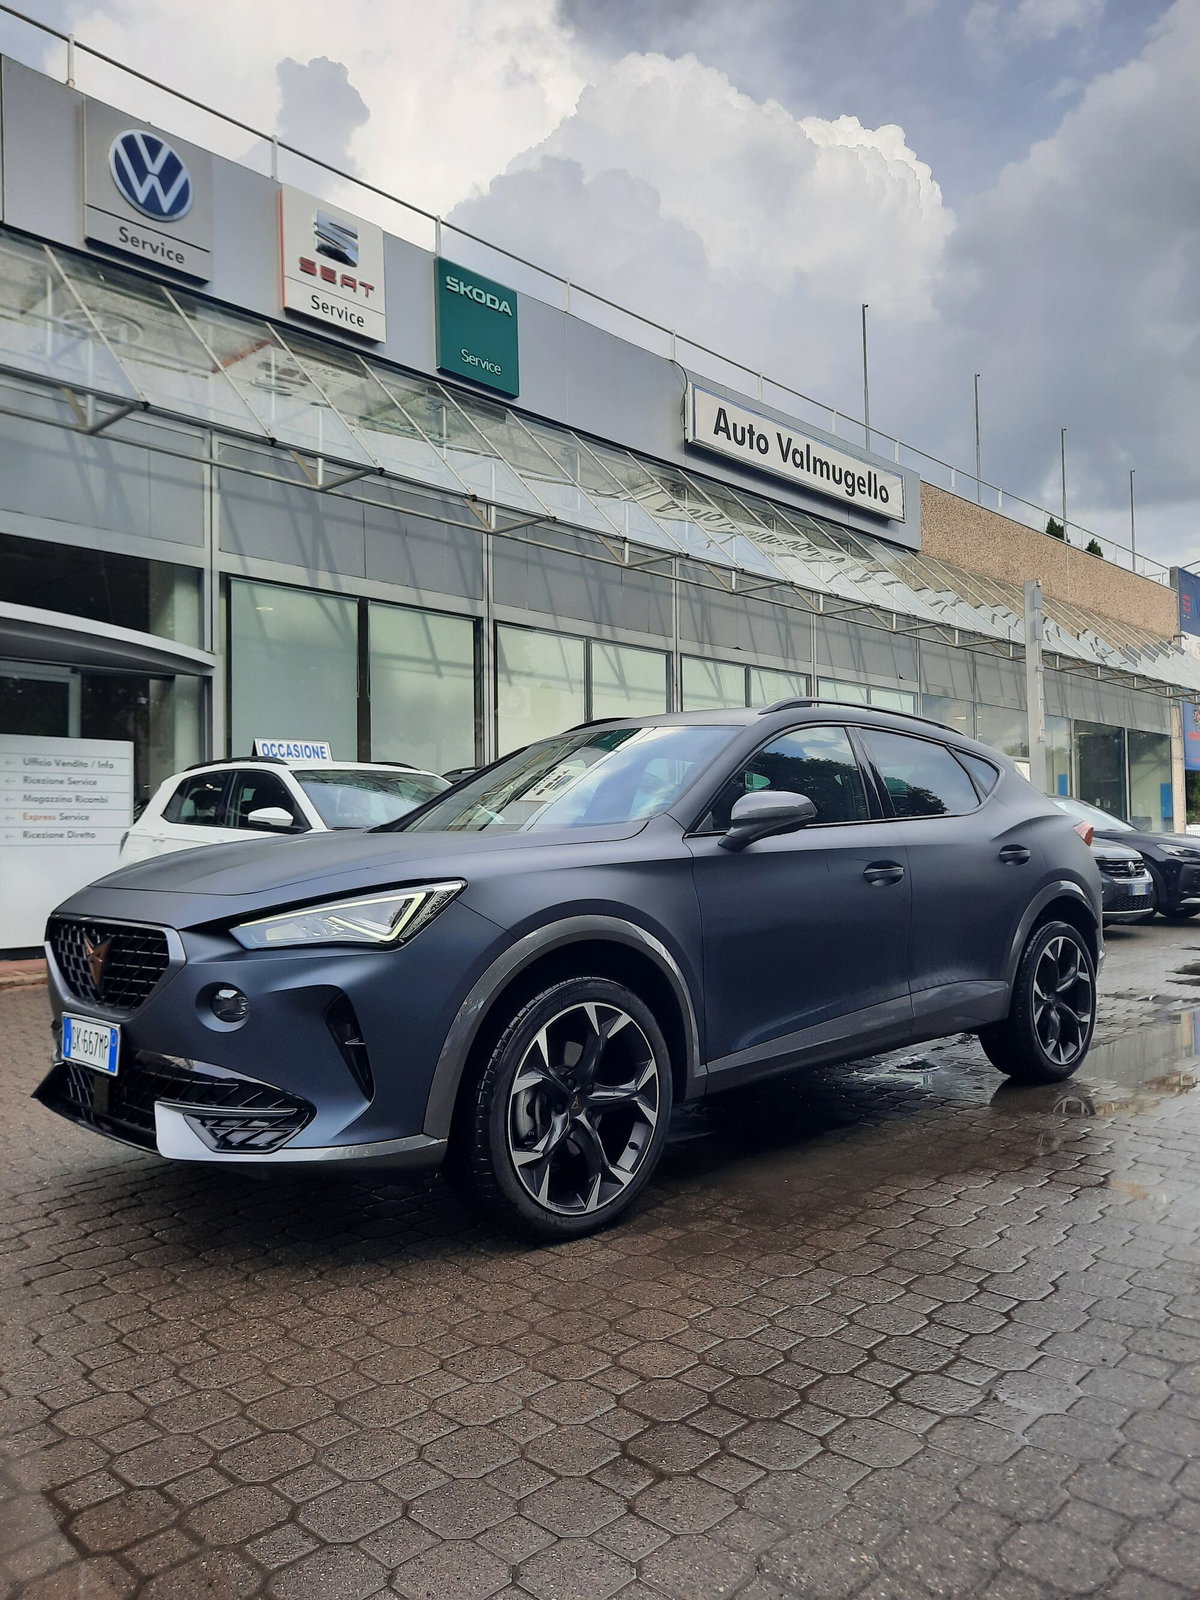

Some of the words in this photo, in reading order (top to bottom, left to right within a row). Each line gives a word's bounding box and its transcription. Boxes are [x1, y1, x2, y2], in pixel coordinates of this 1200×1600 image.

[118, 226, 185, 264] Service
[299, 256, 375, 298] SEAT
[445, 275, 513, 317] SKODA
[310, 294, 365, 327] Service
[460, 348, 502, 375] Service
[713, 407, 769, 455] Auto
[776, 432, 889, 504] Valmugello
[261, 743, 327, 759] OCCASIONE
[23, 757, 52, 767] Ufficio
[97, 760, 114, 769] Info
[23, 775, 65, 785] Ricezione
[67, 777, 98, 786] Service
[23, 794, 73, 804] Magazzino
[75, 795, 109, 804] Ricambi
[22, 812, 57, 822] Express
[59, 812, 90, 821] Service
[23, 830, 65, 839] Ricezione
